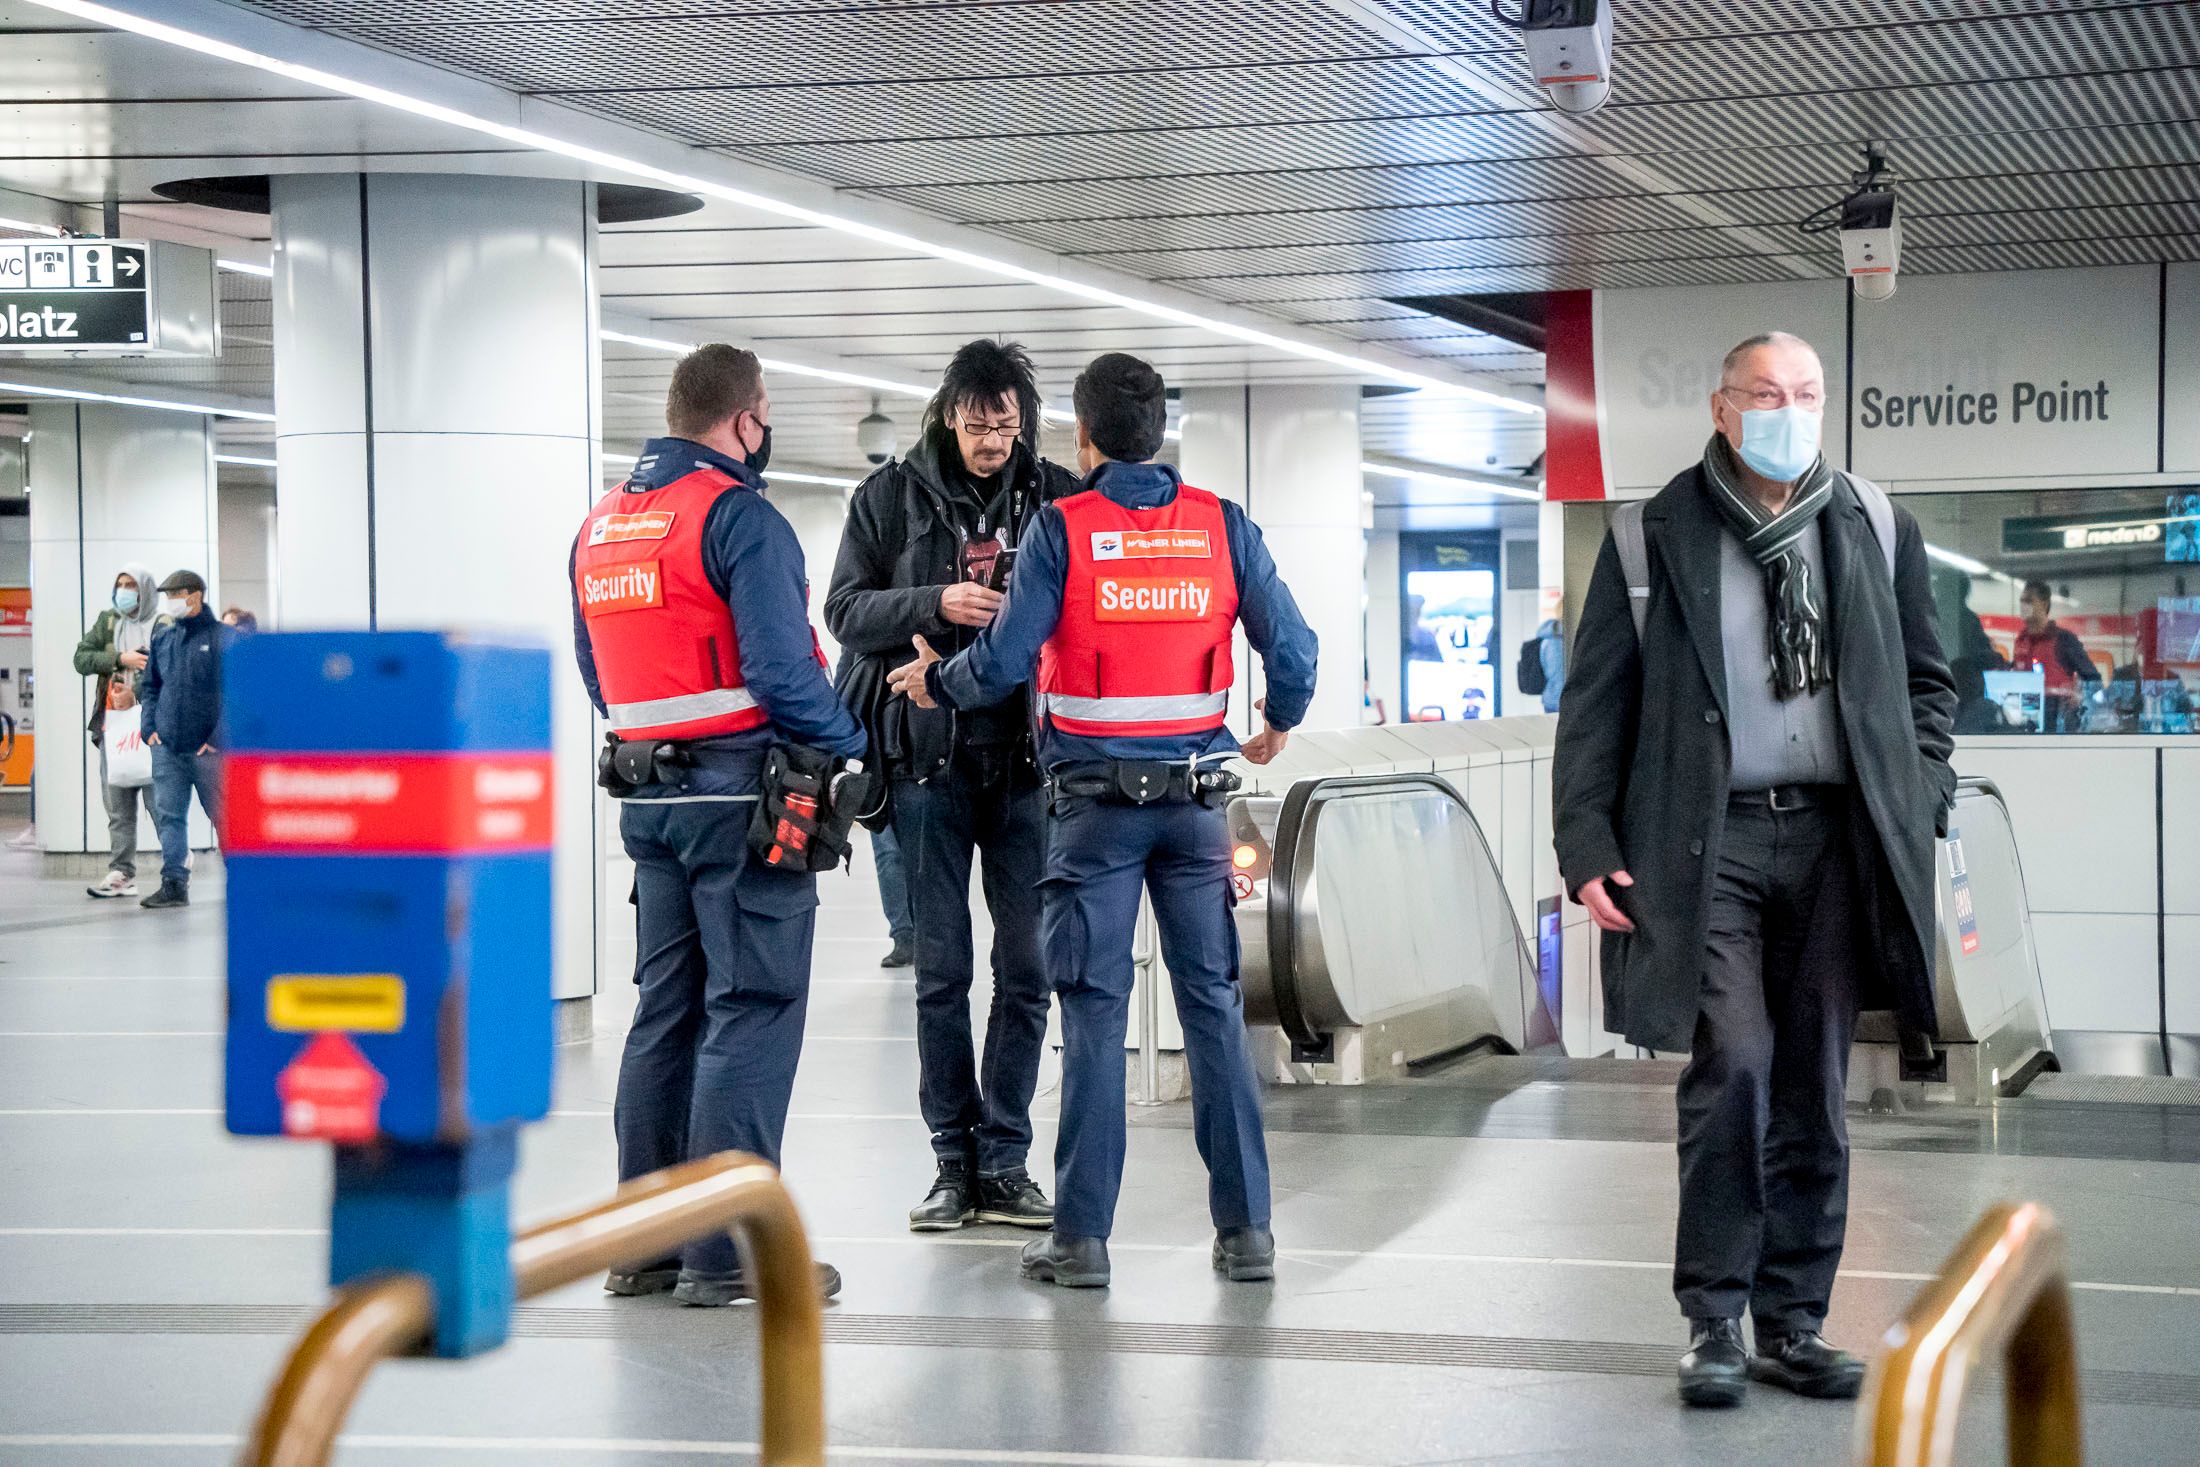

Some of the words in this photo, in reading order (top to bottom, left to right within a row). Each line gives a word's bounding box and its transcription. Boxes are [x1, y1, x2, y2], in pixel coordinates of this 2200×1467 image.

[1859, 385, 1998, 429] Service
[2012, 380, 2110, 425] Point
[1126, 538, 1170, 549] WIENER
[1172, 538, 1206, 548] LINIEN
[584, 567, 655, 604] Security
[1101, 580, 1210, 616] Security
